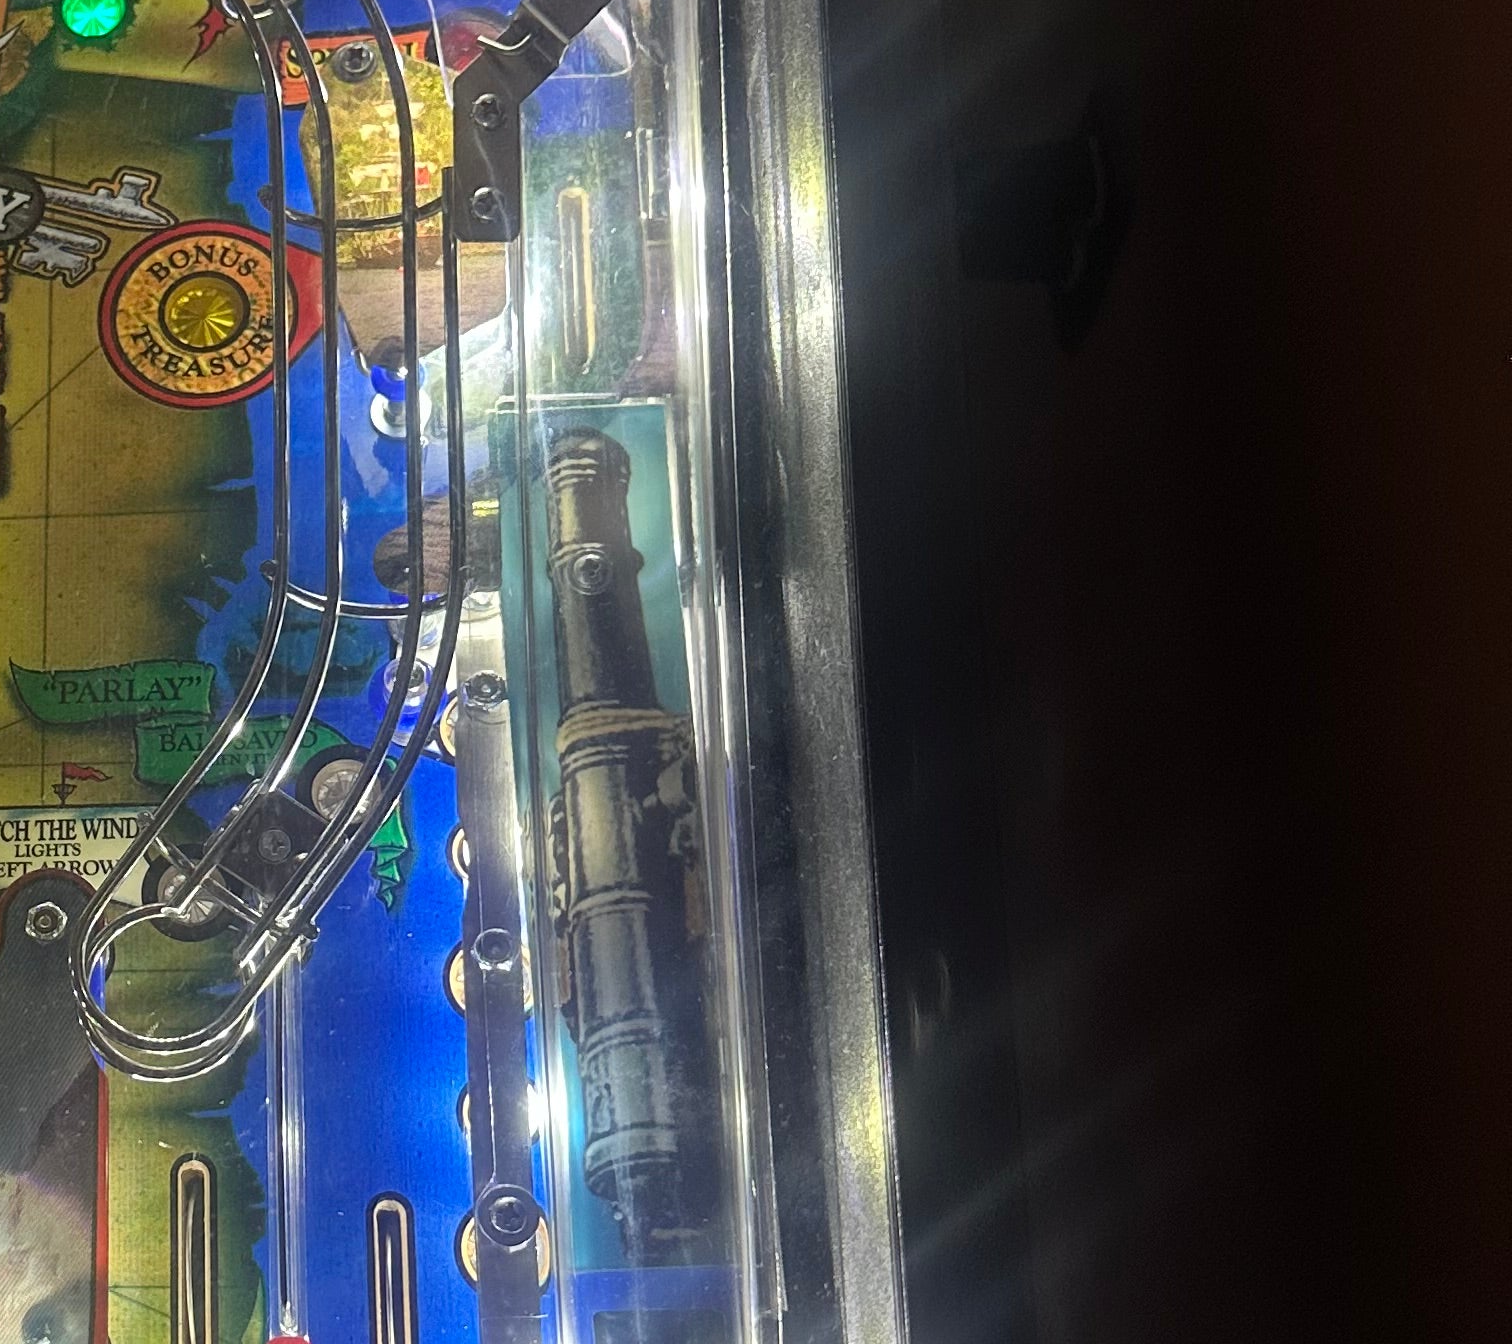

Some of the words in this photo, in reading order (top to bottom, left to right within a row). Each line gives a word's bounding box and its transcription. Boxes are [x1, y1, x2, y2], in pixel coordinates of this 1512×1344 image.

[147, 244, 257, 283] BONUS
[160, 731, 212, 753] BAL
[233, 729, 318, 751] SAVD
[34, 819, 78, 842] THE
[81, 817, 142, 840] WIND
[14, 842, 81, 859] LIGHTS
